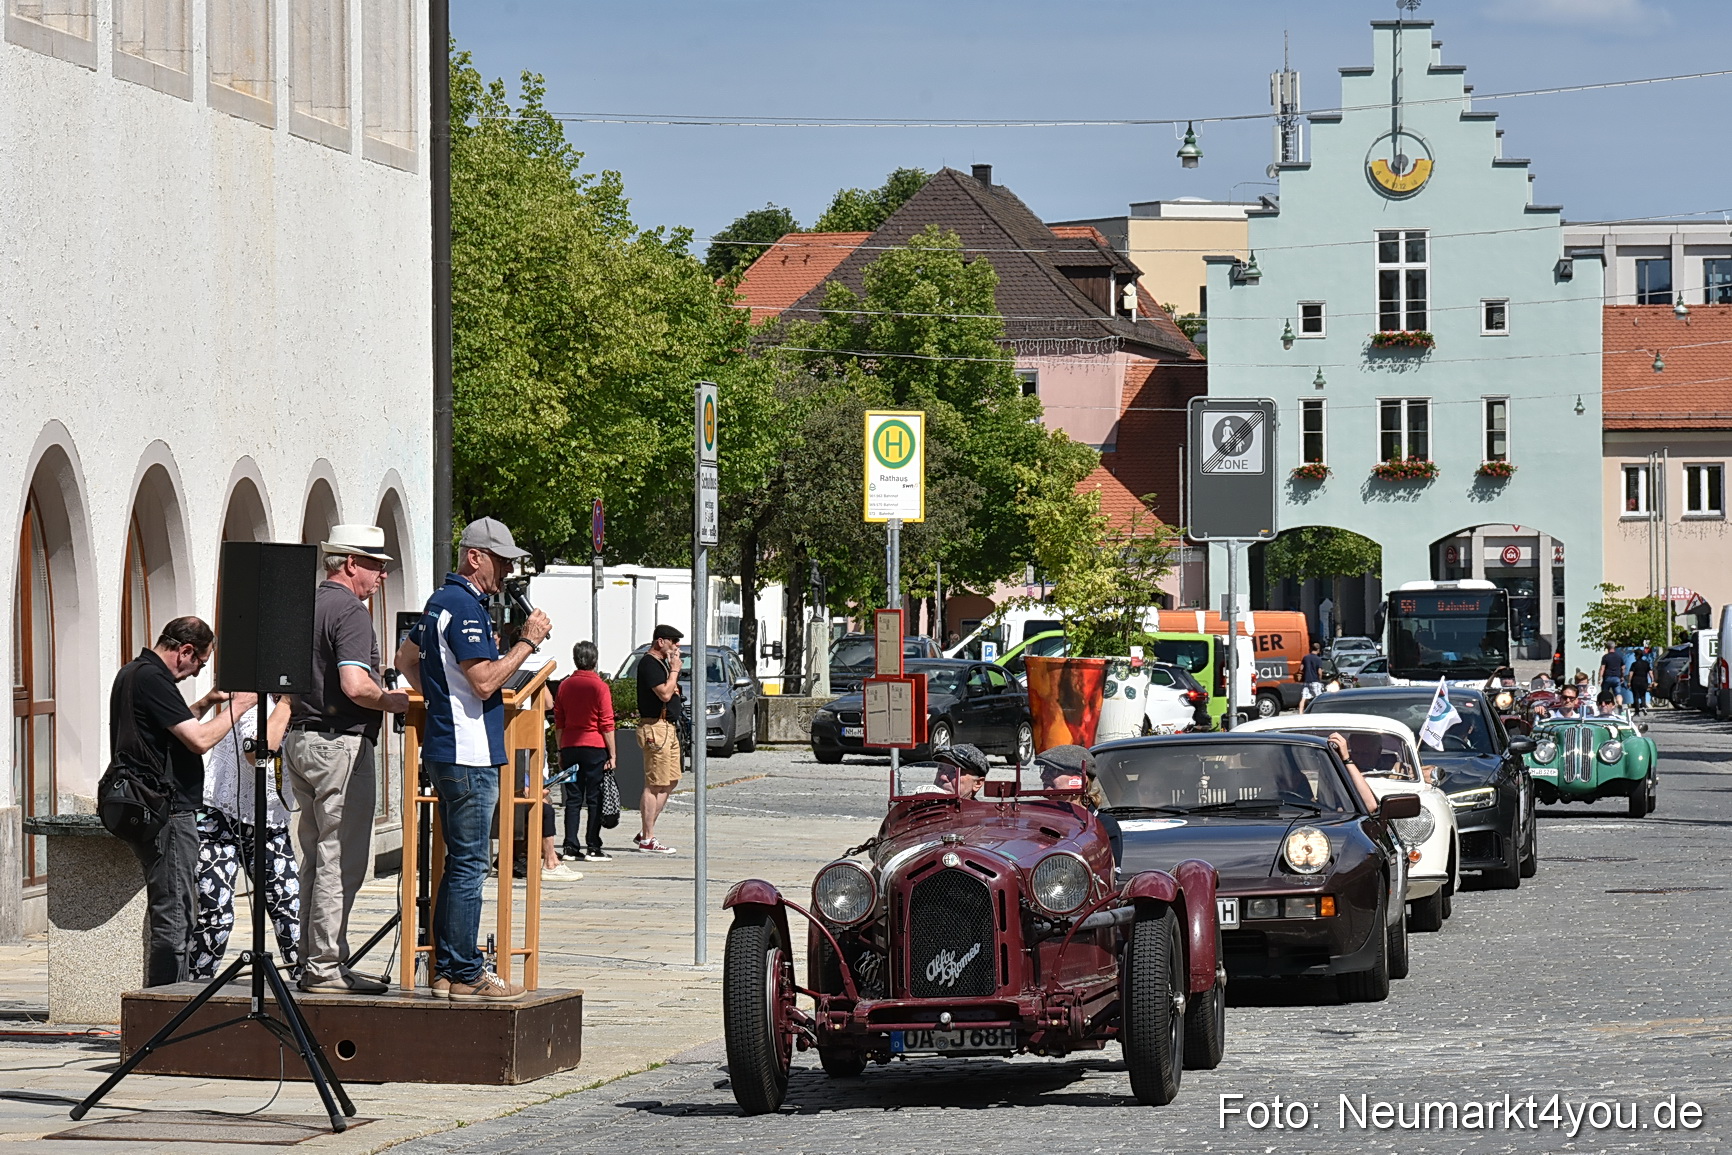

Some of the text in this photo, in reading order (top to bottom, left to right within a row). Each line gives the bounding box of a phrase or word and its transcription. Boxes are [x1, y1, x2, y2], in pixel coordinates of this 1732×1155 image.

[886, 430, 903, 458] H
[1218, 459, 1248, 470] ZONE
[880, 474, 908, 483] Rathaus
